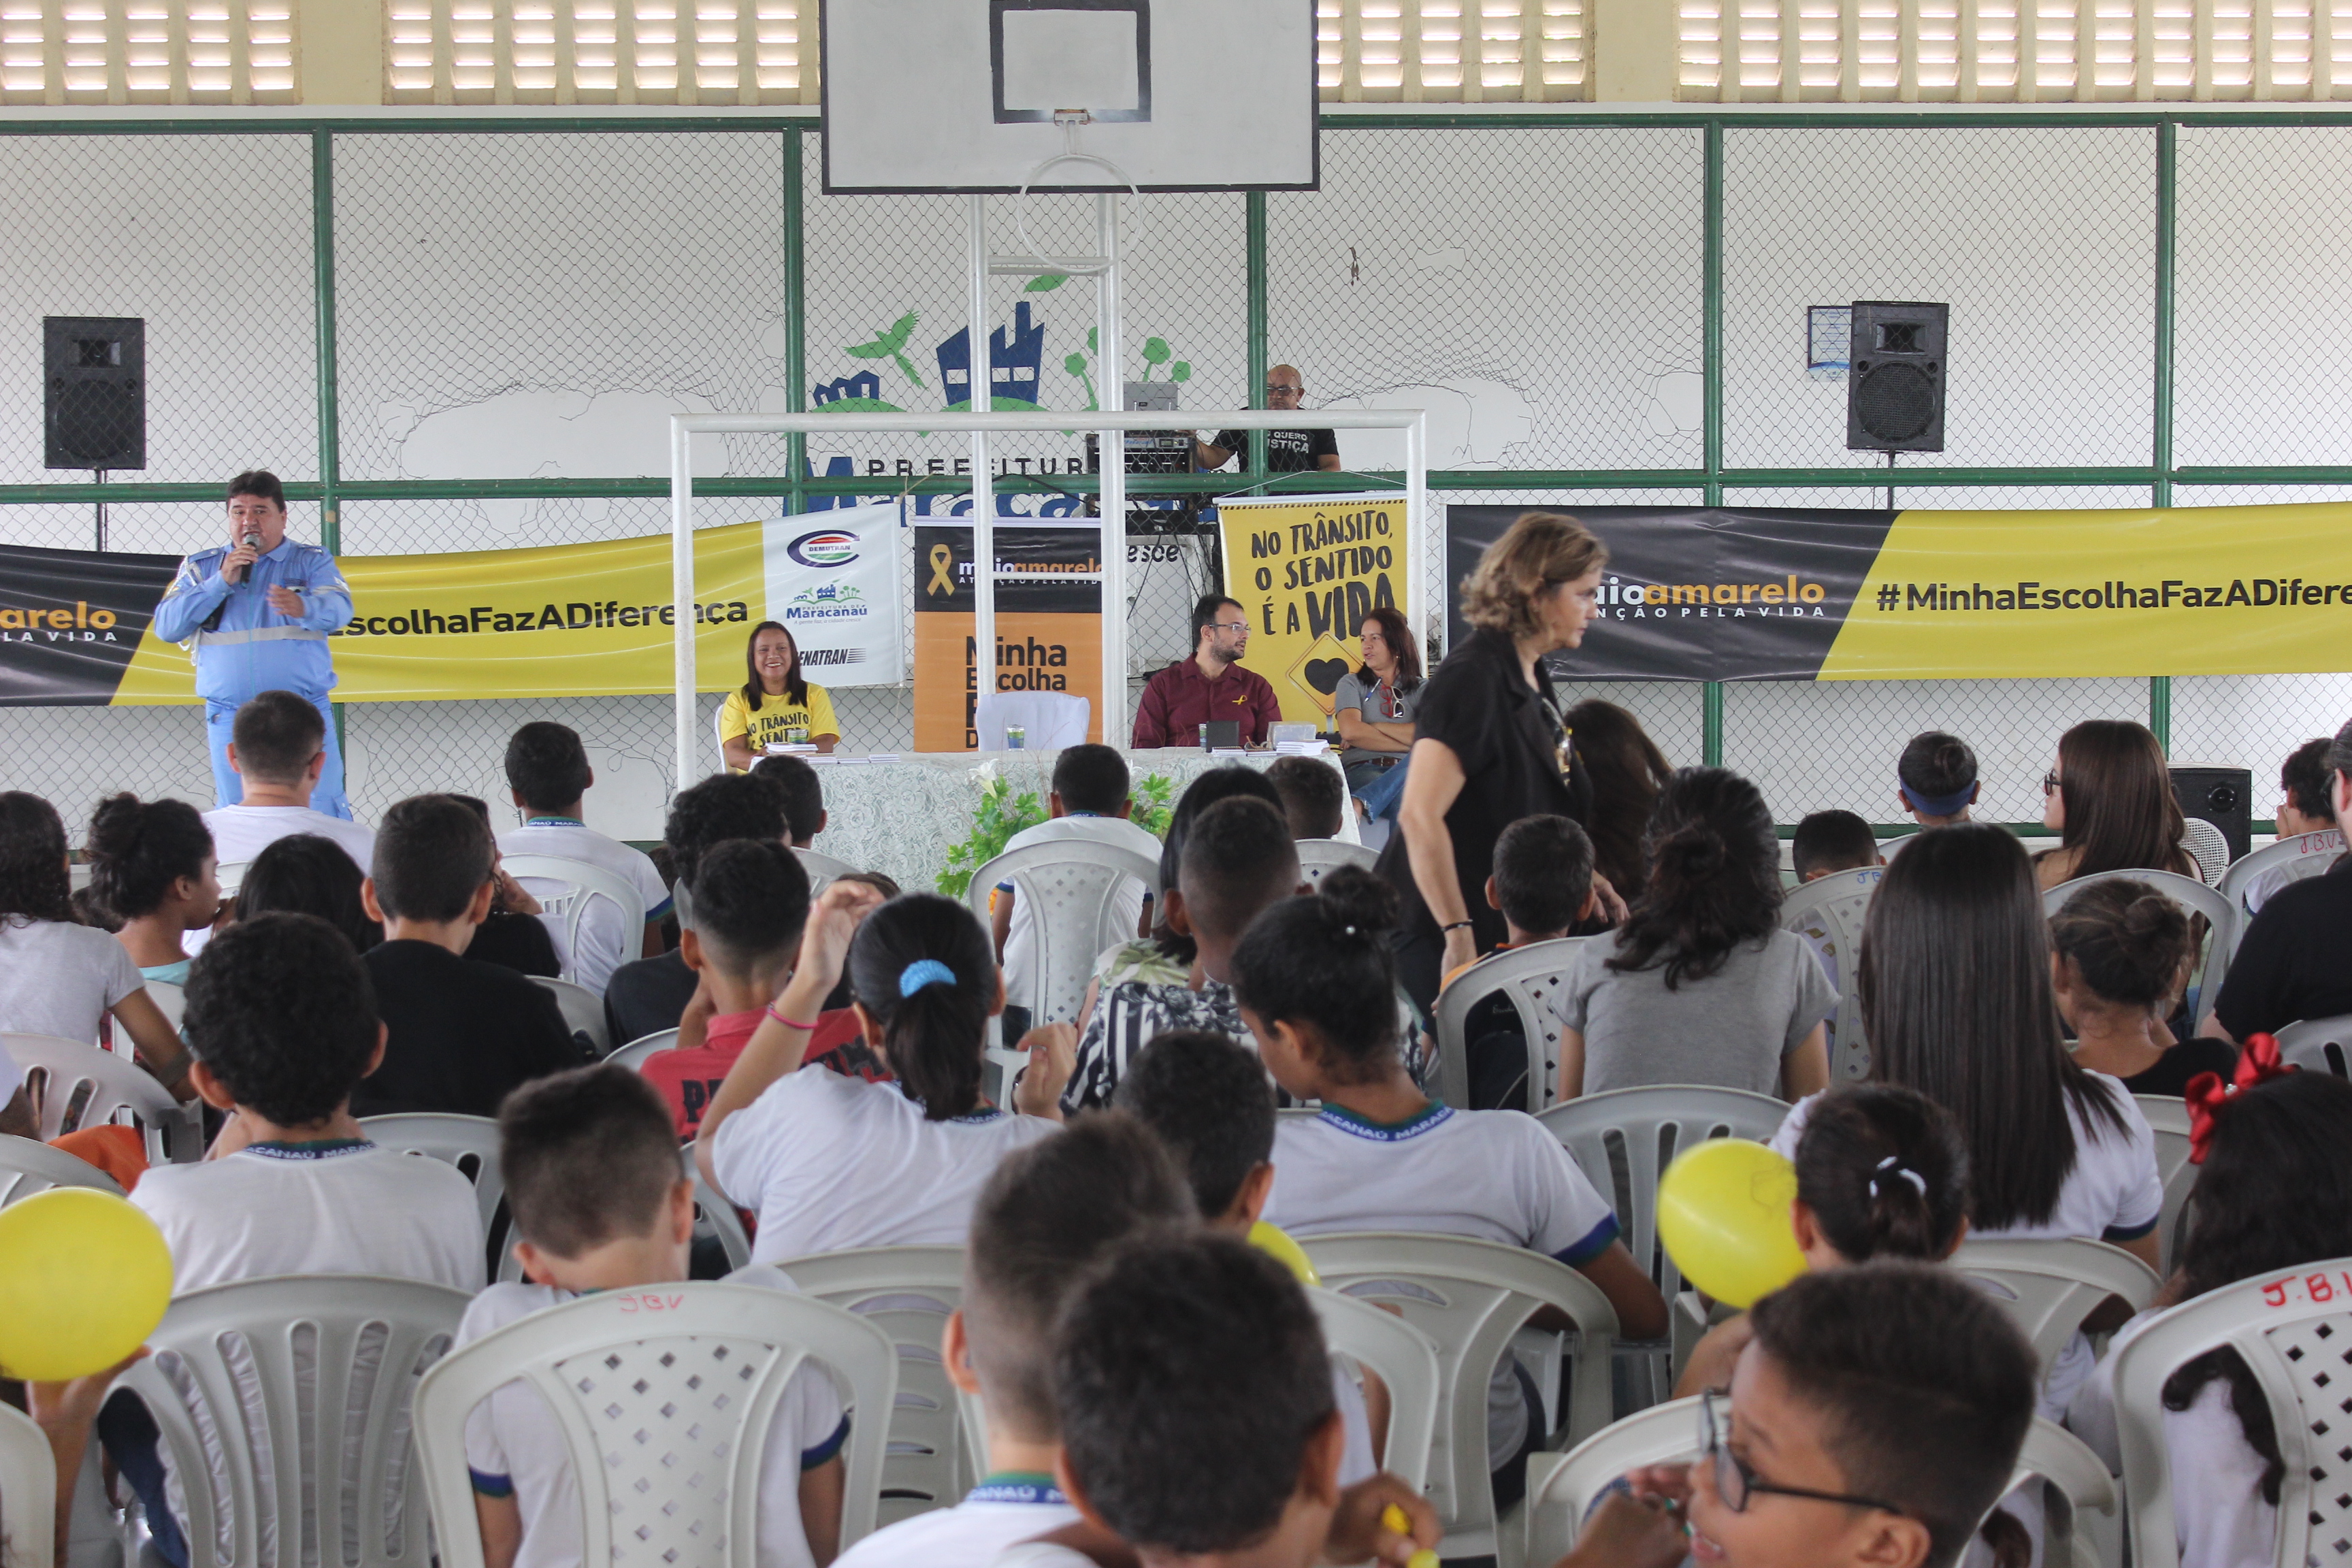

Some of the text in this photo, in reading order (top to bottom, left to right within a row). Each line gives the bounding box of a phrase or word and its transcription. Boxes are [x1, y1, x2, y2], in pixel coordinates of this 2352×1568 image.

[1273, 431, 1308, 441] QUERO
[1252, 510, 1393, 558] NO TRÂNSITO,
[1128, 545, 1179, 562] esce
[959, 557, 1102, 575] mioamarel
[1255, 545, 1392, 591] O SENTIDO
[1595, 575, 1825, 605] ioamarelo
[1877, 578, 2352, 611] #MinhaEscolhaFazADifere
[0, 600, 117, 630] arelo
[787, 605, 868, 619] Maracanaú
[1262, 572, 1396, 642] É A VIDA
[1595, 606, 1825, 621] NÇÃO PELA VIDA
[329, 601, 748, 637] scolhaFazADiferença
[3, 632, 117, 642] LA VIDA
[799, 648, 848, 666] ENATRAN
[966, 668, 1066, 691] Ecolha
[617, 1293, 685, 1312] JBV
